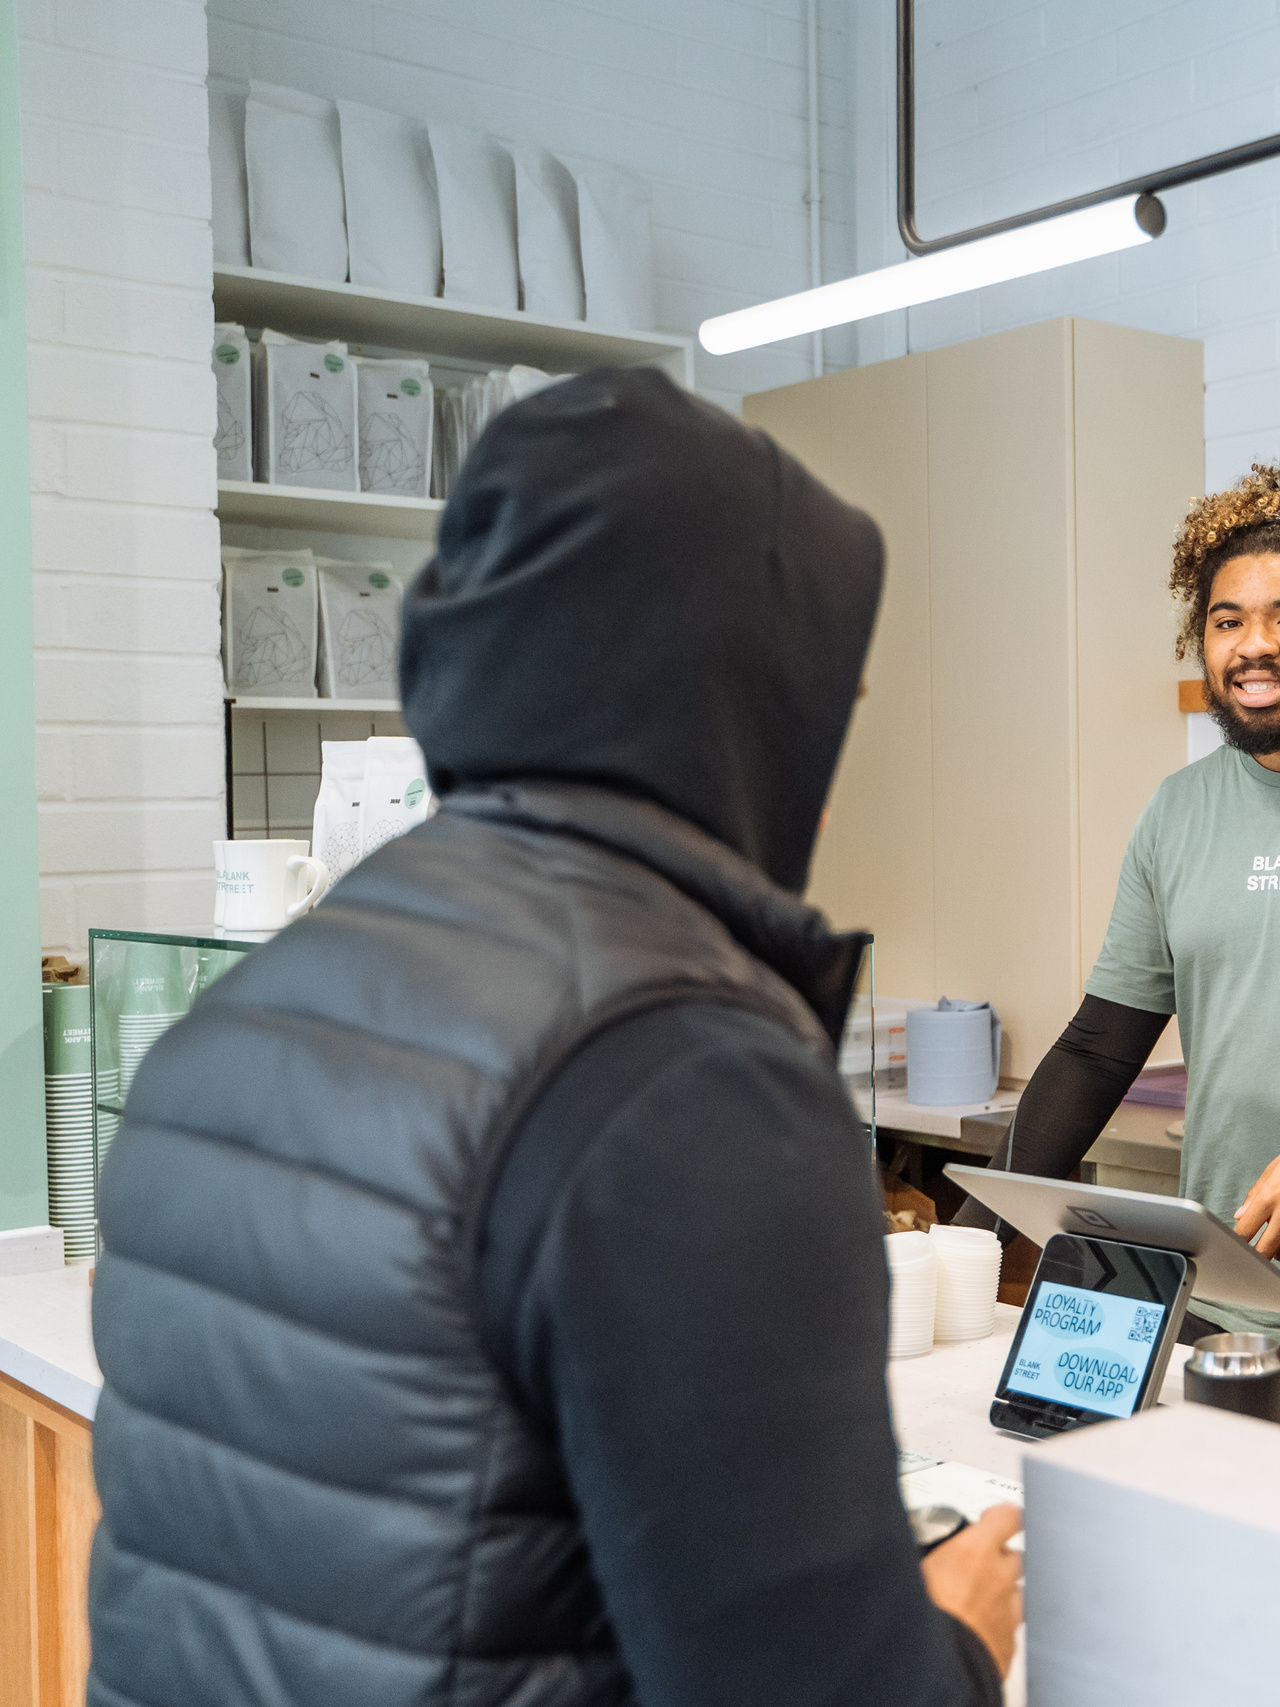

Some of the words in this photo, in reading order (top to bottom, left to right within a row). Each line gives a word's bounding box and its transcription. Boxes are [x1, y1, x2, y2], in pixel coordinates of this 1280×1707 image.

[1045, 1294, 1098, 1317] LOYALTY
[1035, 1309, 1101, 1336] PROGRAM
[1014, 1368, 1040, 1380] STREET
[1019, 1359, 1042, 1370] BLANK
[1058, 1352, 1139, 1384] DOWNLOAD
[1064, 1372, 1094, 1393] OUR
[1095, 1381, 1123, 1398] APP
